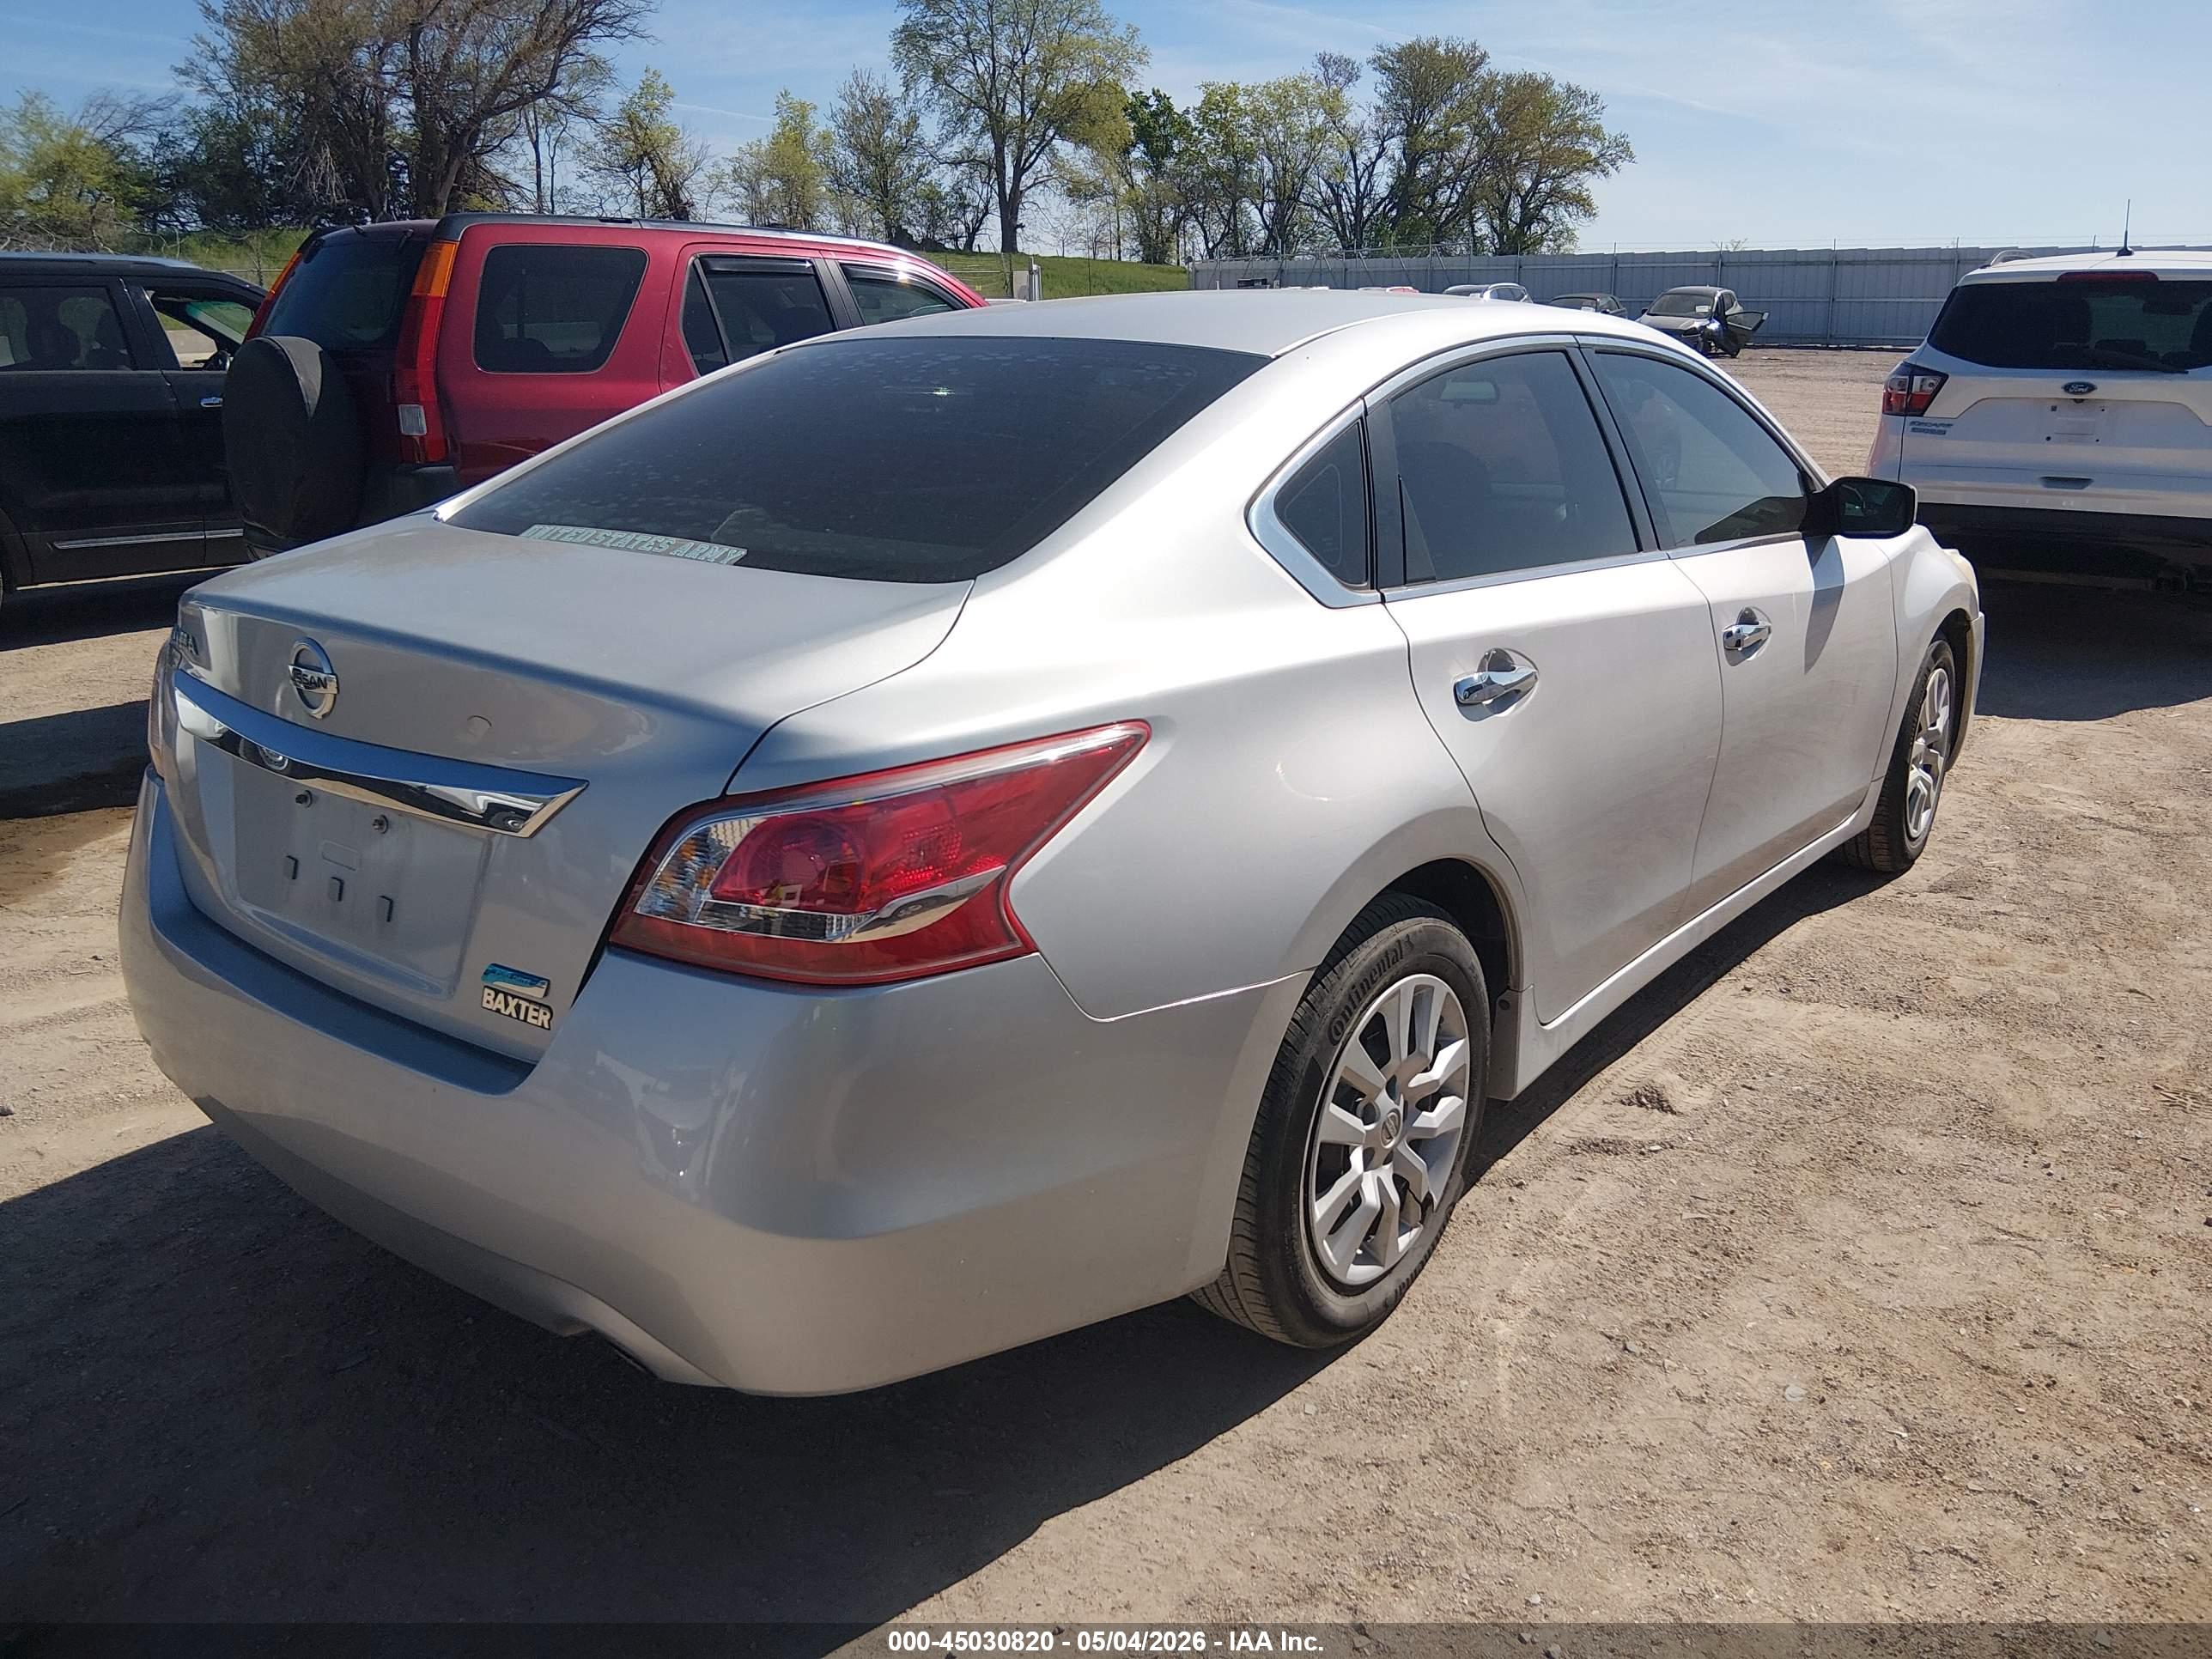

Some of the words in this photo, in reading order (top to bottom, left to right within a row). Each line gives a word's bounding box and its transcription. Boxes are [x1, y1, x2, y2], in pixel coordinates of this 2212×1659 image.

[525, 526, 593, 543] UNITED
[590, 530, 676, 553] STATES
[669, 541, 748, 564] ARMY
[482, 986, 551, 1030] BAXTER
[1327, 939, 1406, 1046] Continental
